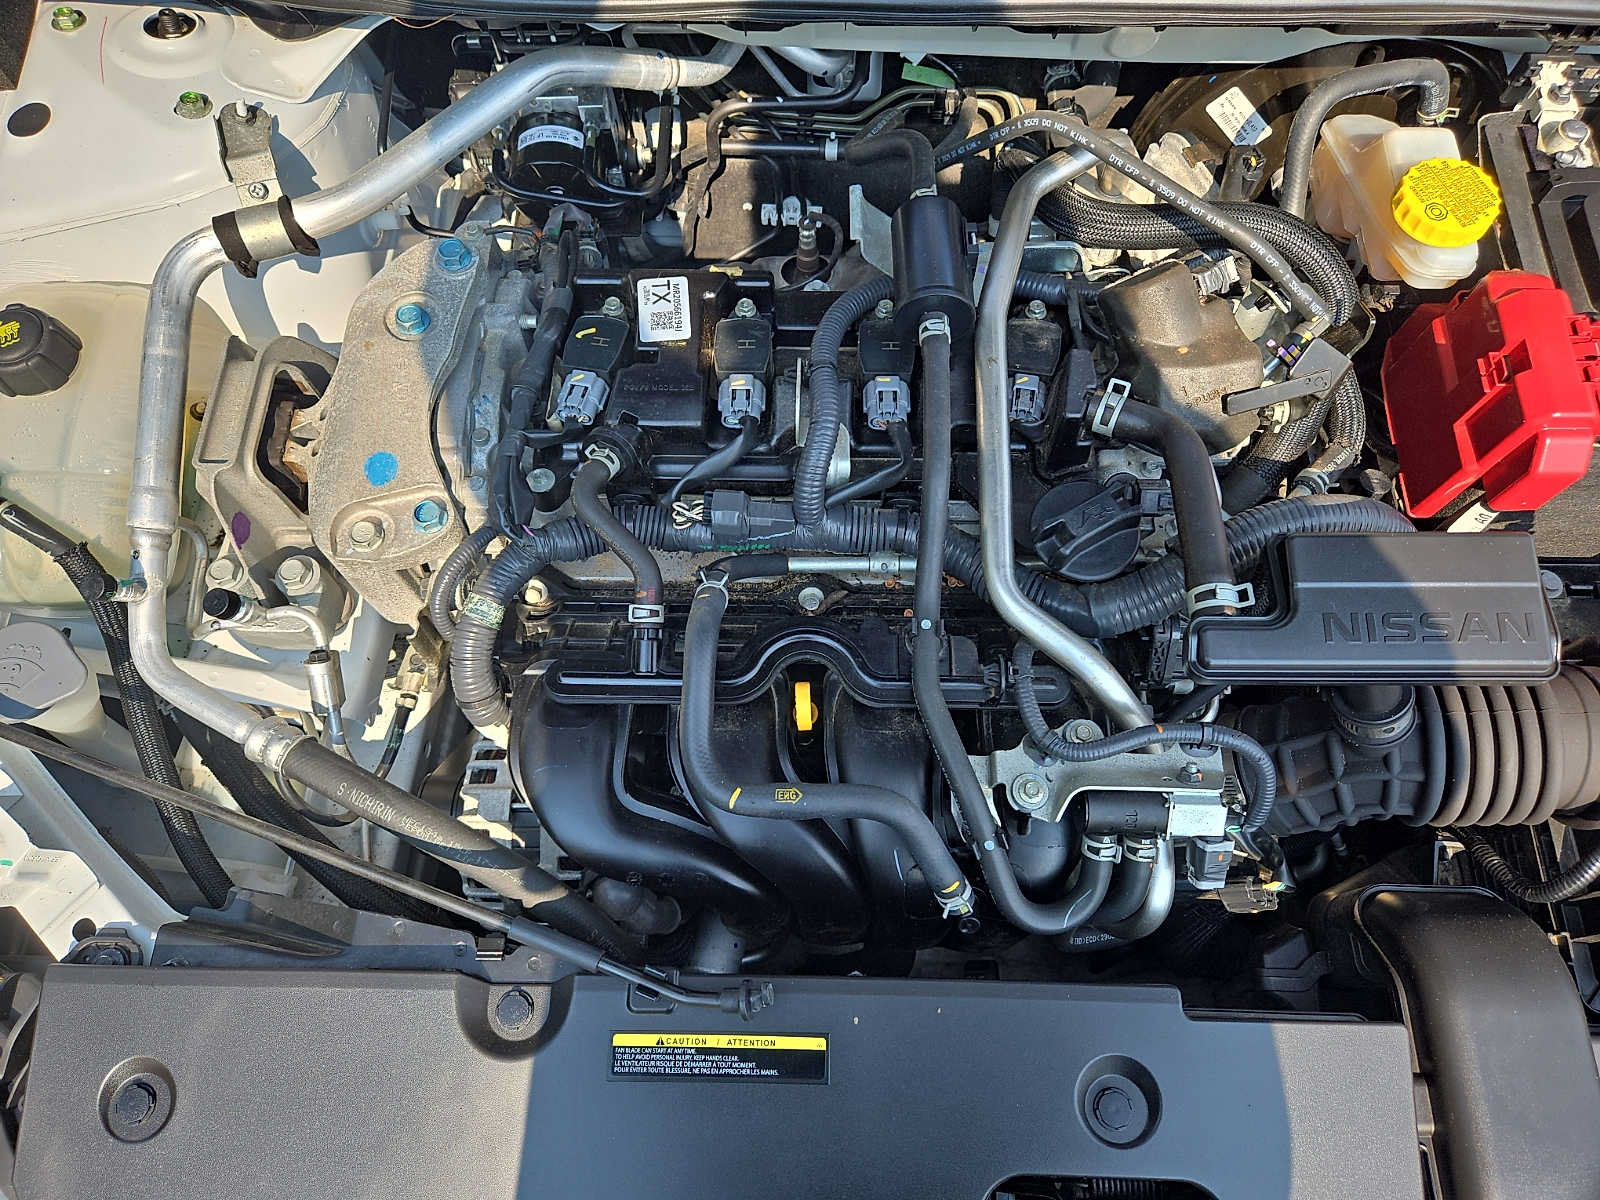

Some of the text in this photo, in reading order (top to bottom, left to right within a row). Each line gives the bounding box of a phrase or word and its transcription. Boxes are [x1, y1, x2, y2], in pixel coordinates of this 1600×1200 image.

[1054, 122, 1067, 133] NOT
[1070, 130, 1089, 145] KINK
[1108, 153, 1123, 168] DTR
[1157, 183, 1176, 199] 3509
[1177, 196, 1188, 207] DO
[1189, 206, 1205, 217] NOT
[1206, 213, 1226, 230] KINK
[1250, 240, 1266, 255] DTR
[651, 280, 671, 305] TX
[1321, 611, 1538, 645] NISSAN
[666, 1037, 707, 1046] CAUTION
[726, 1038, 776, 1047] ATTENTION
